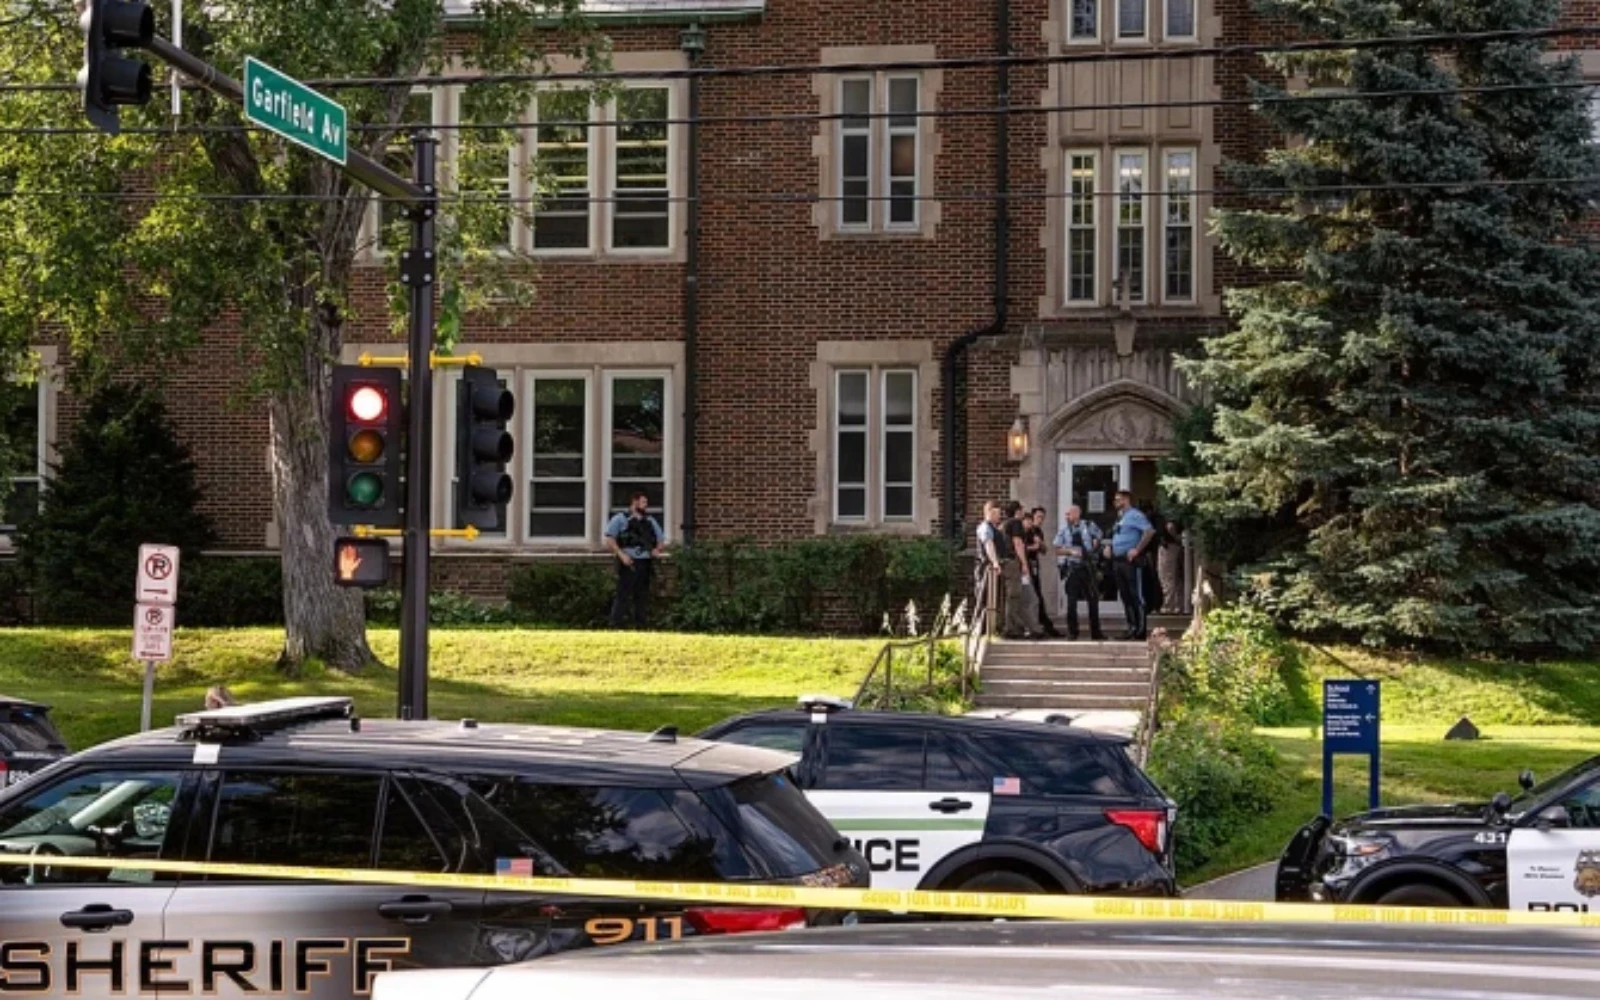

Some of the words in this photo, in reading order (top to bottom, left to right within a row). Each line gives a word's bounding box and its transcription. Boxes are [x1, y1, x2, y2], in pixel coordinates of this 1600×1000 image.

[253, 76, 314, 134] Garfield
[322, 113, 340, 146] Av
[584, 915, 683, 944] 911
[0, 937, 410, 995] SHERIFF
